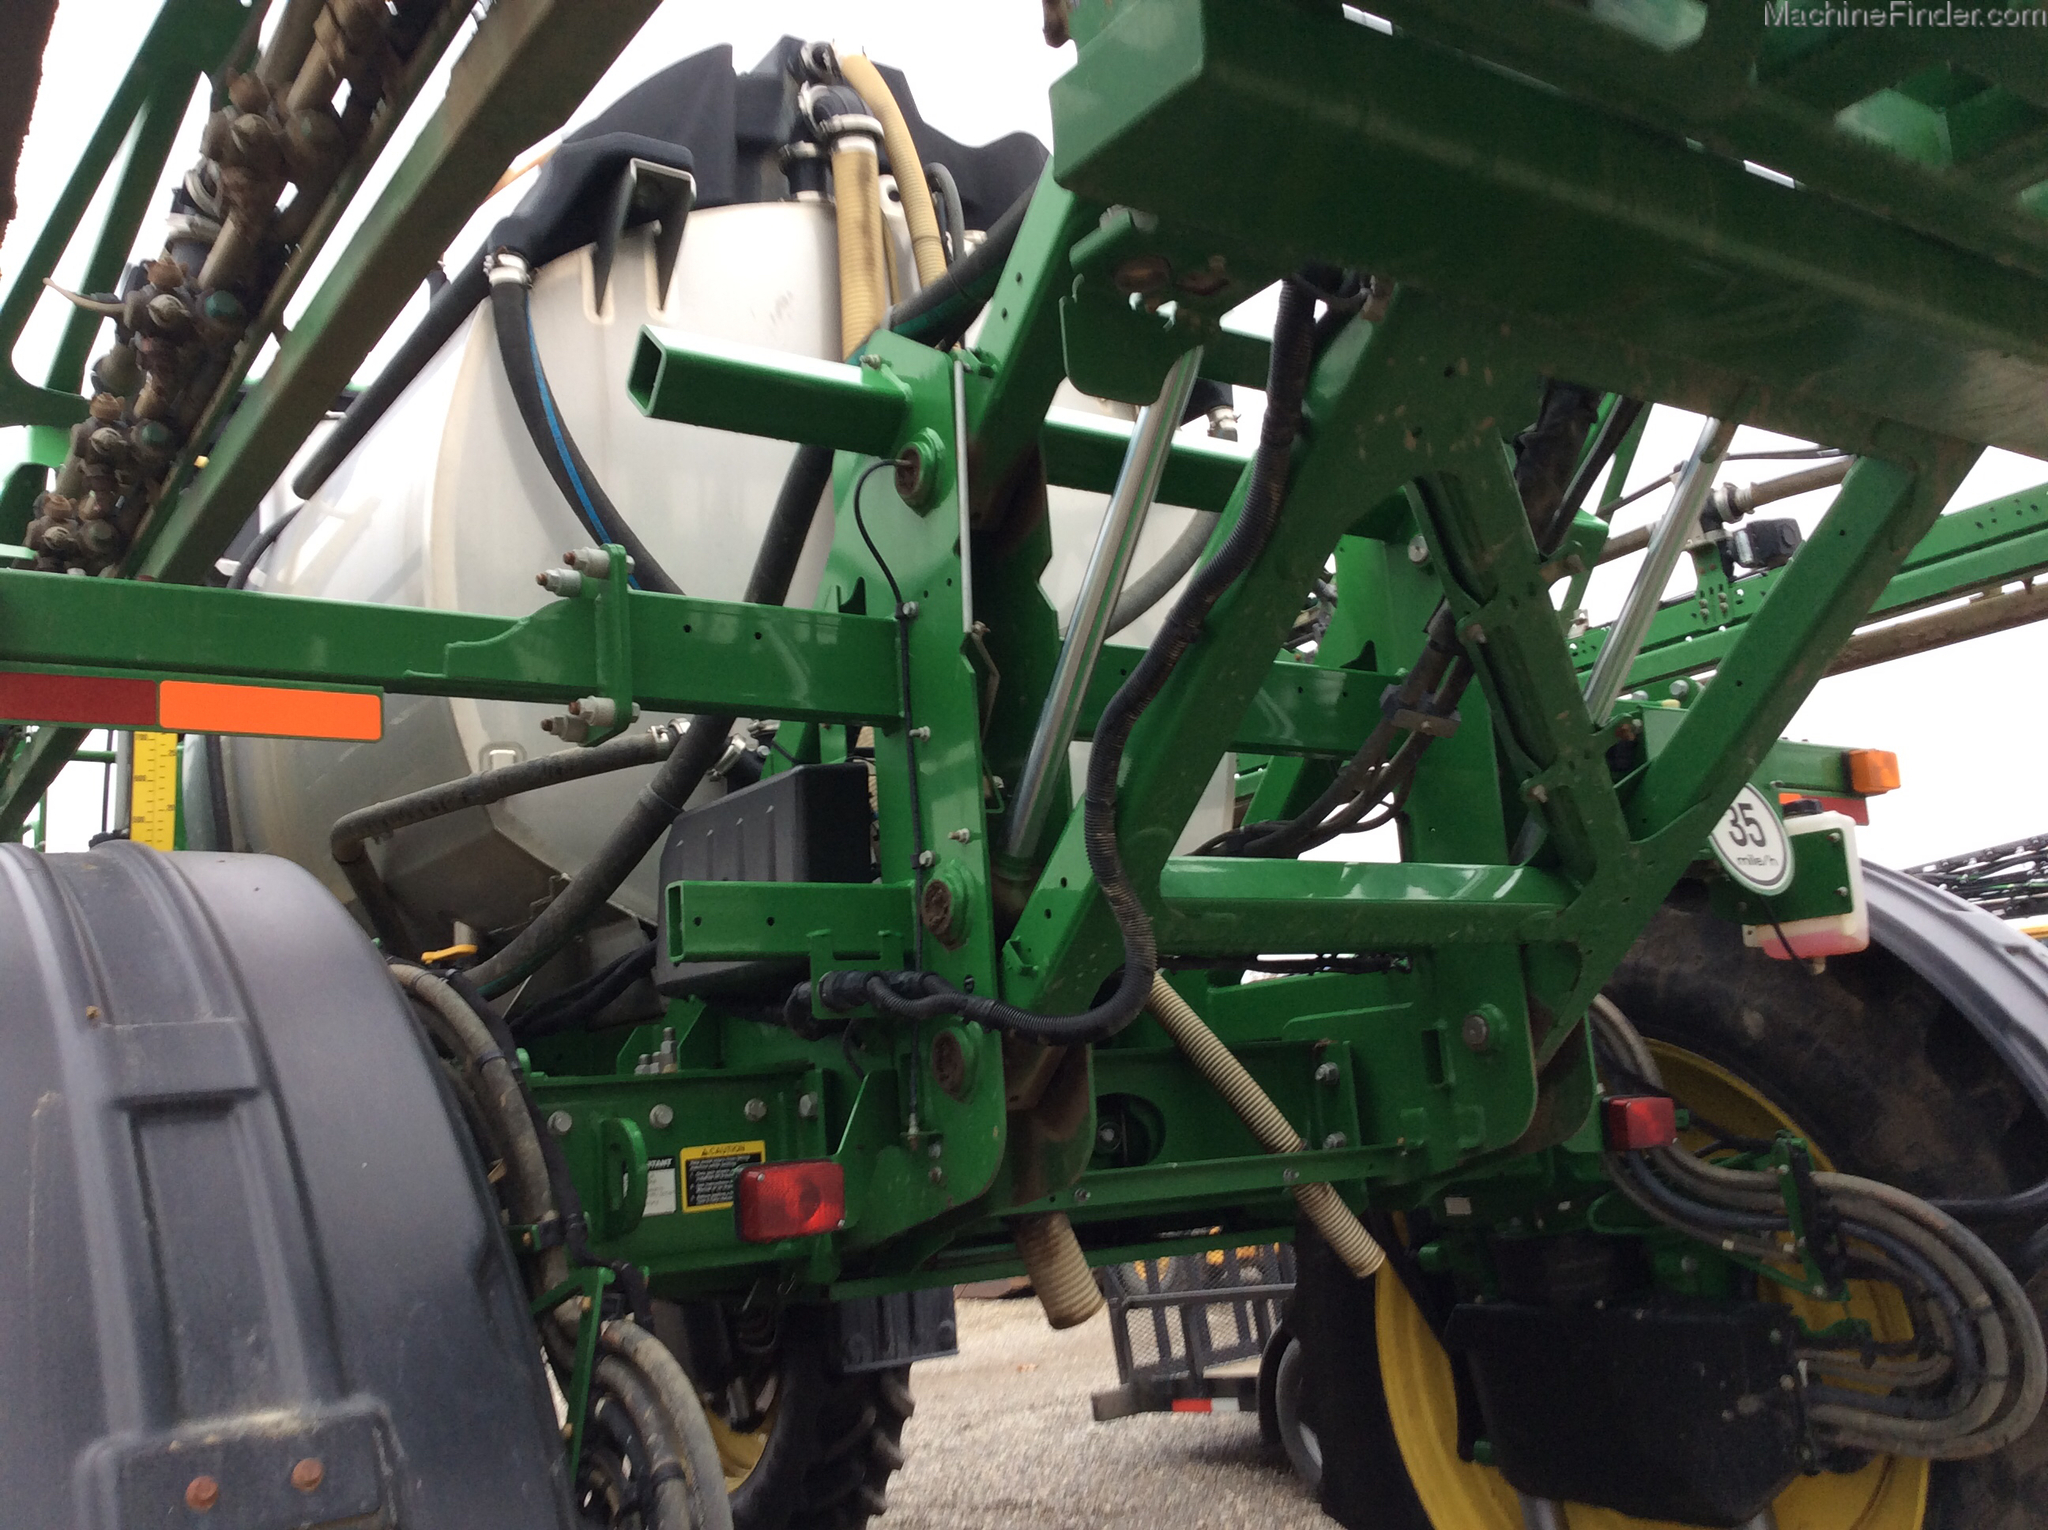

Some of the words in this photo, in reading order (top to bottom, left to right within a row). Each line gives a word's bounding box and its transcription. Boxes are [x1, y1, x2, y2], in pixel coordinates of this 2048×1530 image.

[1728, 803, 1766, 847] 35
[1736, 854, 1779, 866] mile/h
[709, 1144, 745, 1155] CAUTION
